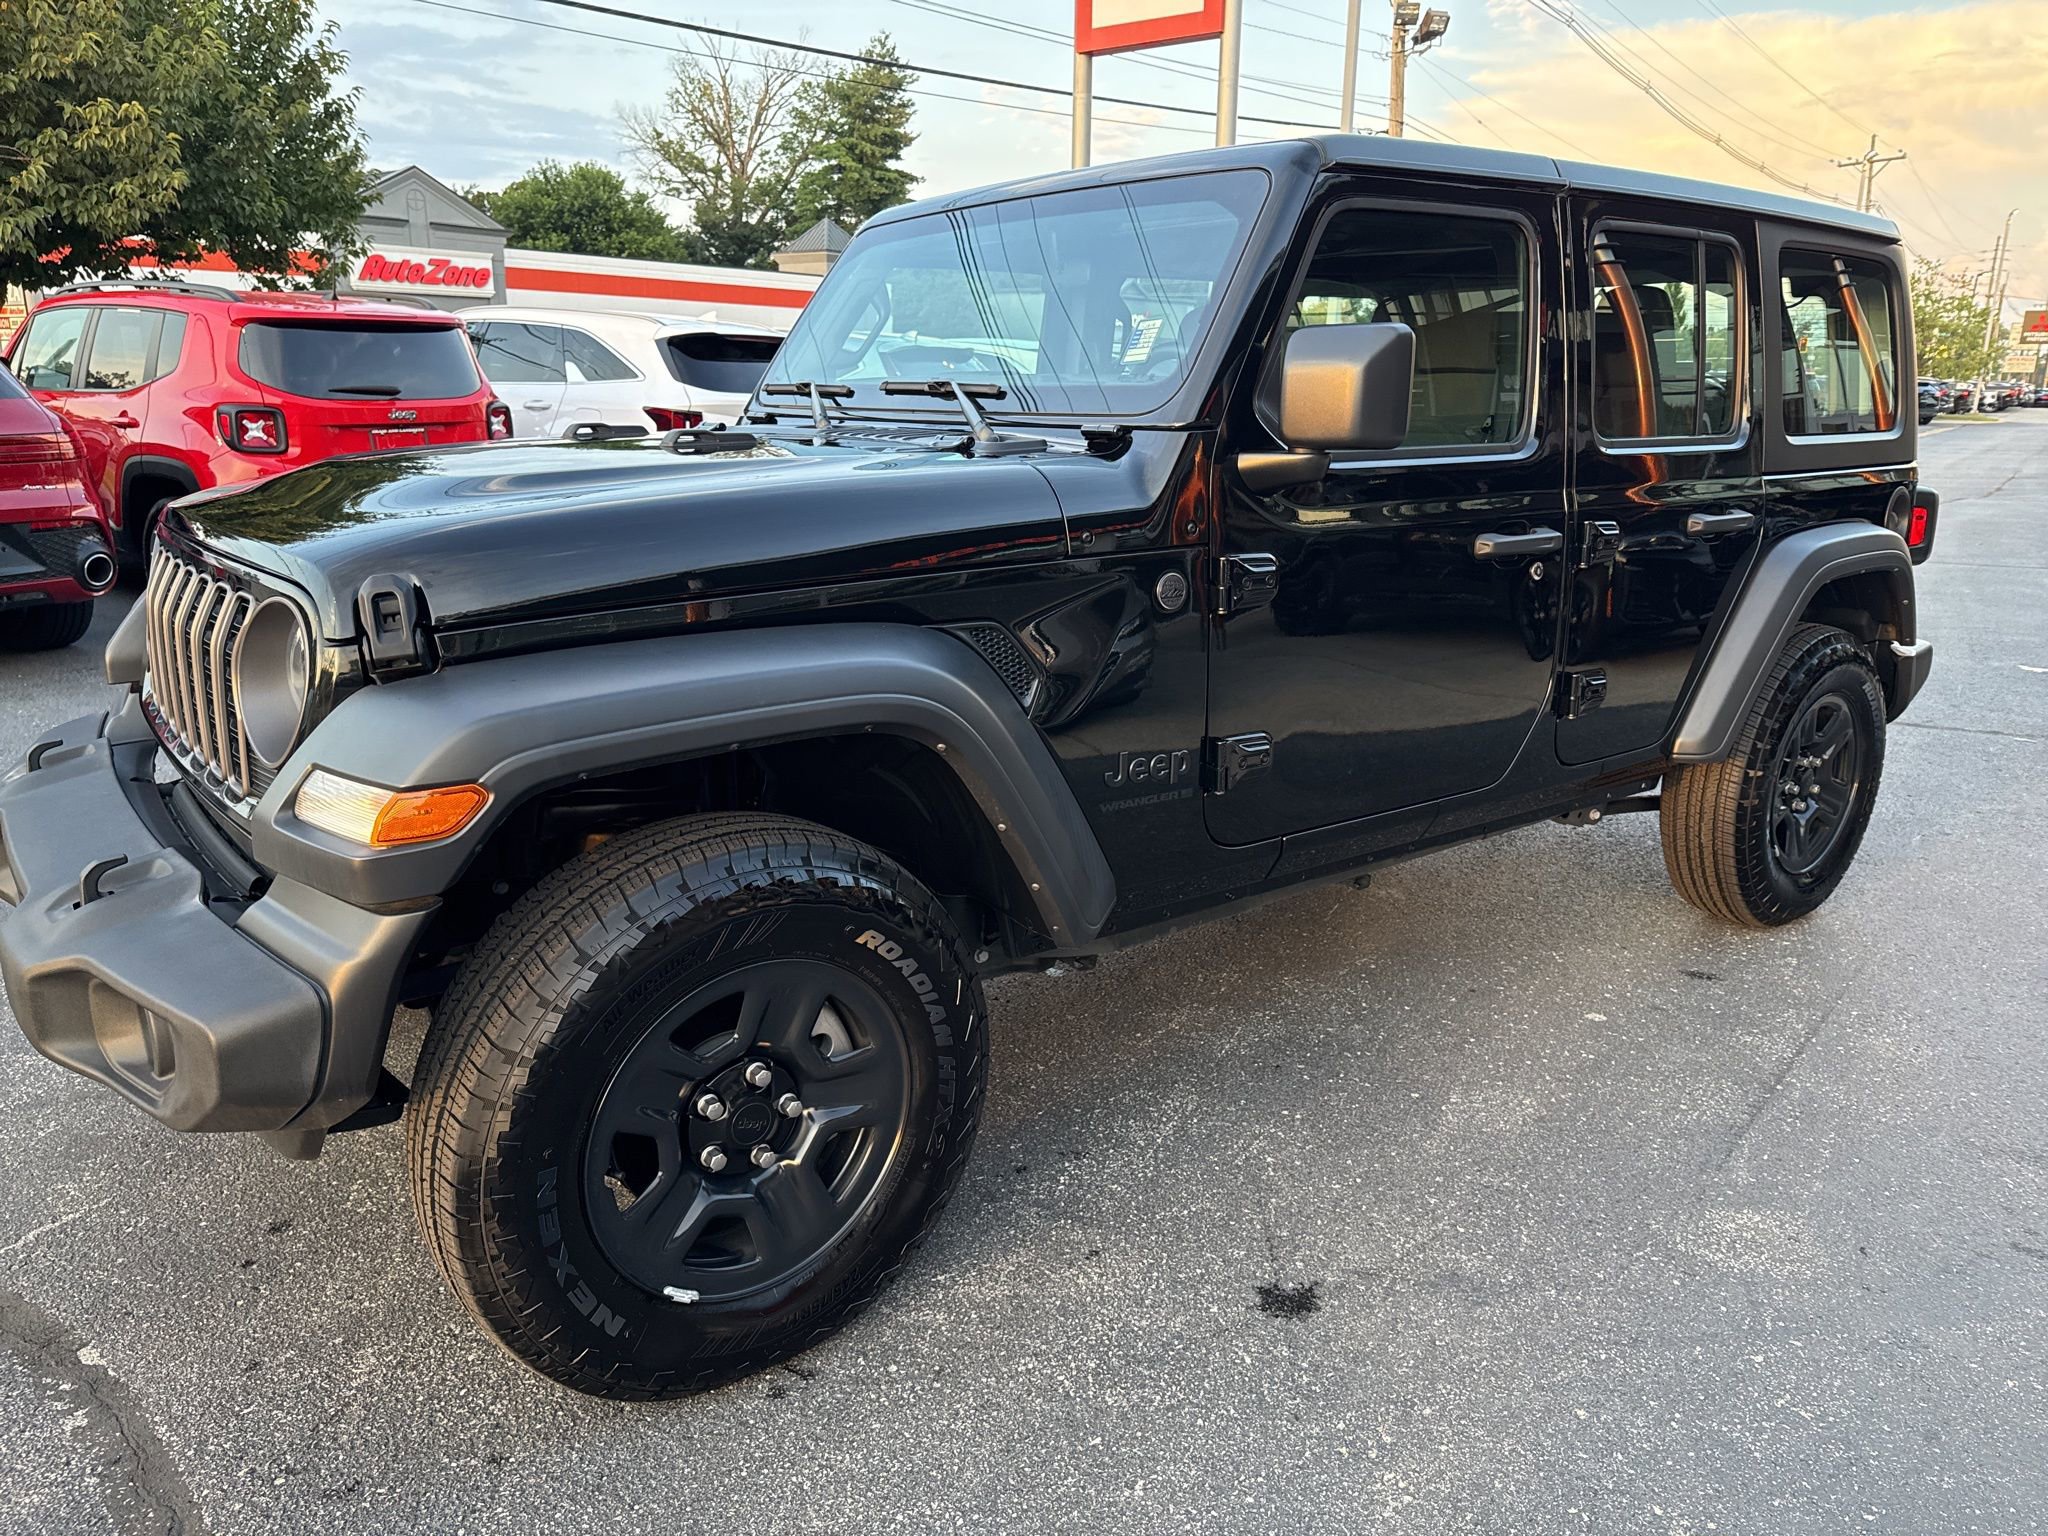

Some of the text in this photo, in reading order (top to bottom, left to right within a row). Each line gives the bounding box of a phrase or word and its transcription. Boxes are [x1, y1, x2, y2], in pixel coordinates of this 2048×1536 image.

[358, 253, 491, 288] AutoZone
[1104, 749, 1190, 787] Jeep
[1101, 791, 1179, 813] WRANGLER
[854, 929, 954, 1047] ROADIAN
[536, 1165, 627, 1338] NEXEN
